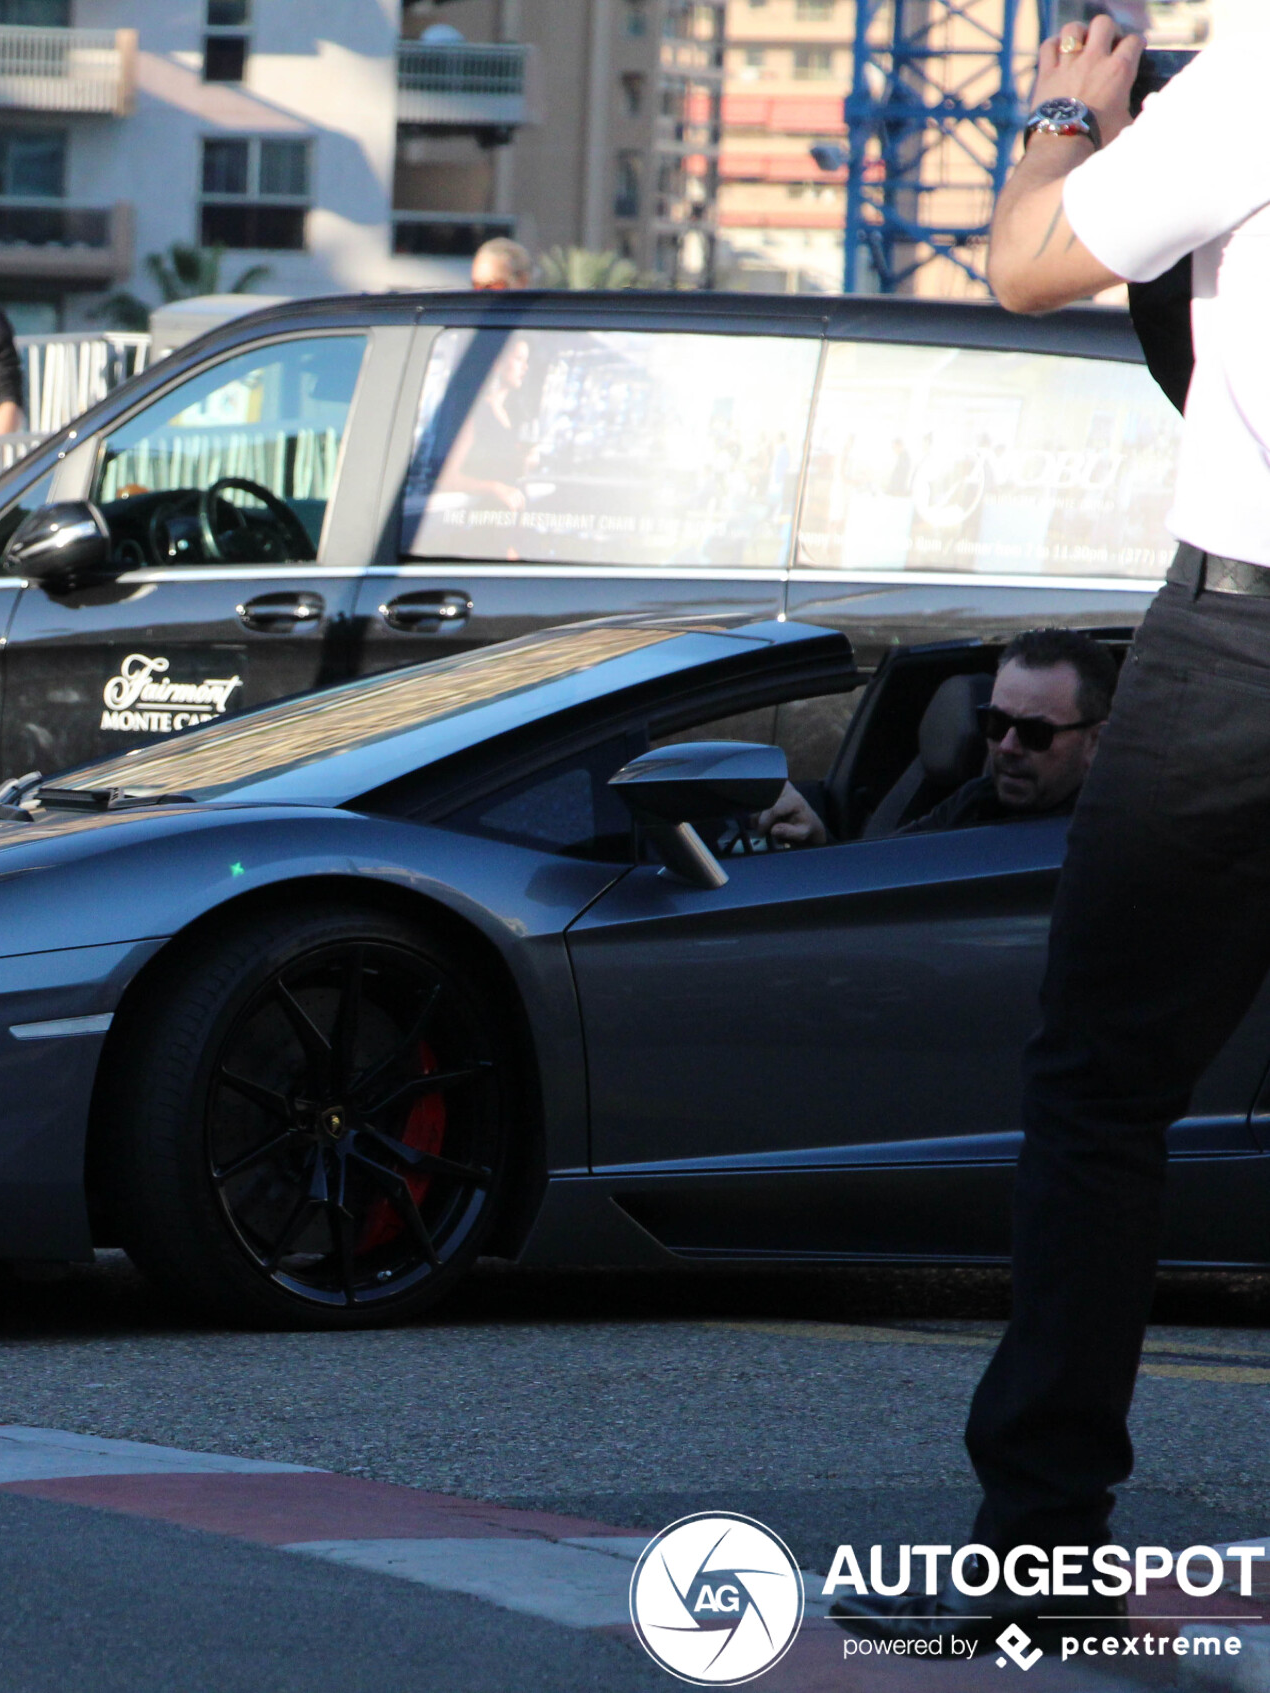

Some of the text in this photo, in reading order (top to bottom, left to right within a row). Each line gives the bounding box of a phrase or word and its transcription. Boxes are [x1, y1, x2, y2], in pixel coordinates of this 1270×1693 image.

[521, 511, 596, 530] RESTAURANT
[103, 653, 243, 712] Fairmont
[100, 711, 172, 732] MONTE
